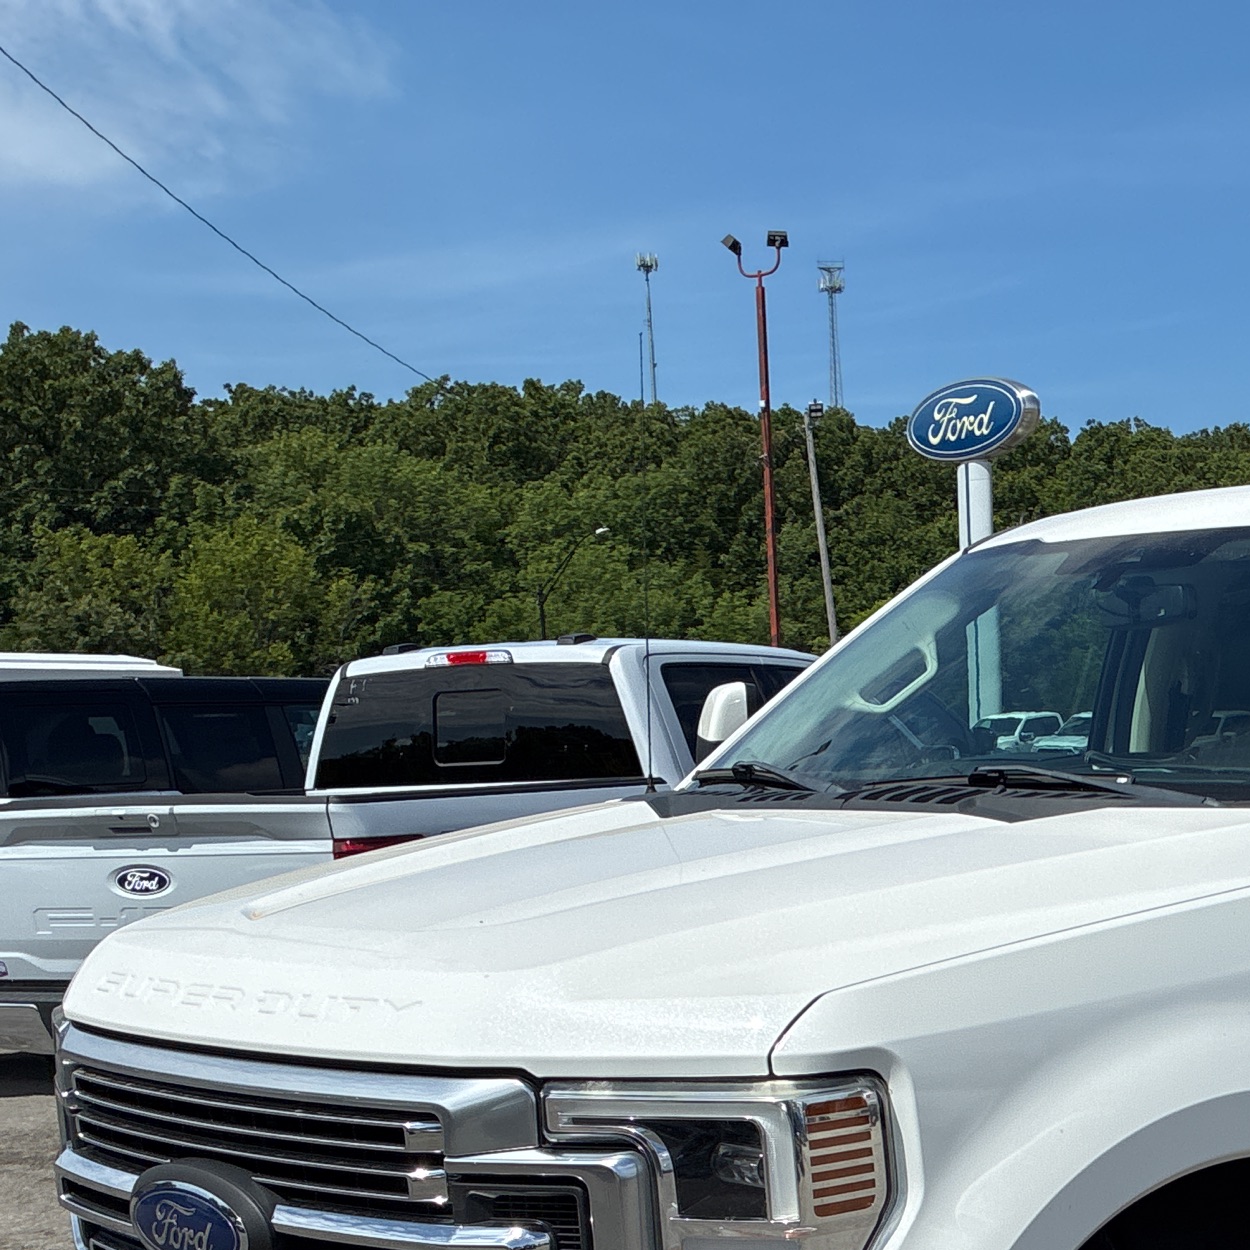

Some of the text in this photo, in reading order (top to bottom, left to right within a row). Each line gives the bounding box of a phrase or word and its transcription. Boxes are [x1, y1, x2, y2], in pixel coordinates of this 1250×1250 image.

[927, 394, 996, 445] Ford
[124, 871, 159, 890] Ford
[96, 970, 423, 1020] SUPER DUTY
